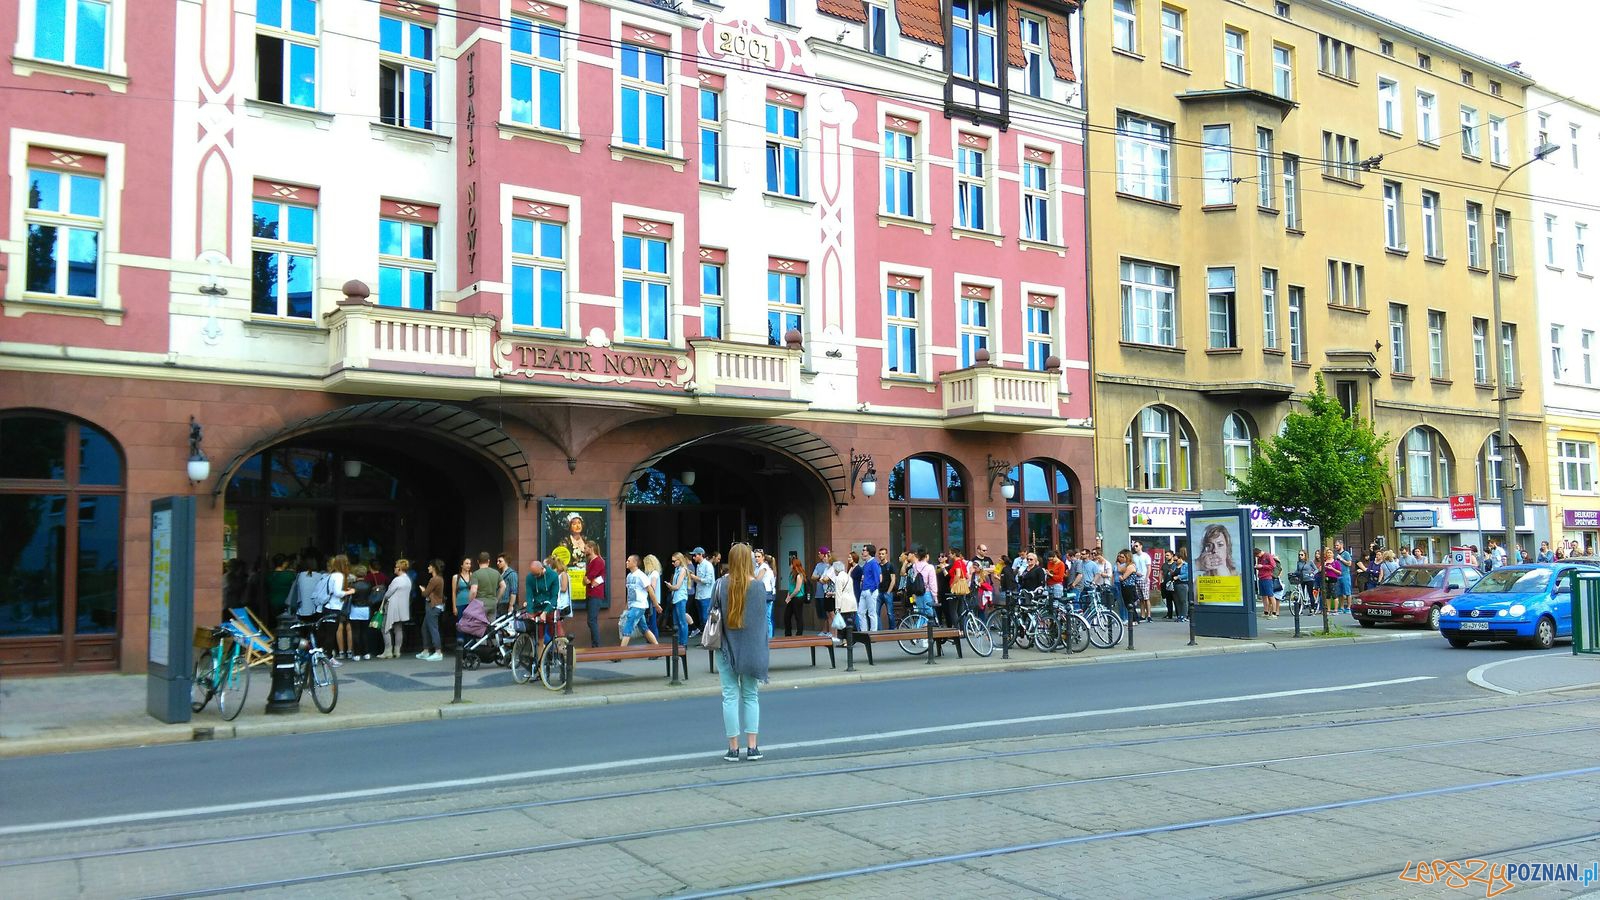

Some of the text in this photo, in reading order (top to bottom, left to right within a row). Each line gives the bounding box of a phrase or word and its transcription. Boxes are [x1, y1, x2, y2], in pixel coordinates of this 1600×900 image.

[720, 32, 770, 62] 2001
[466, 51, 477, 274] TEATR NOWY
[516, 345, 677, 378] TEATR NOWY
[1132, 505, 1195, 516] GALANTER
